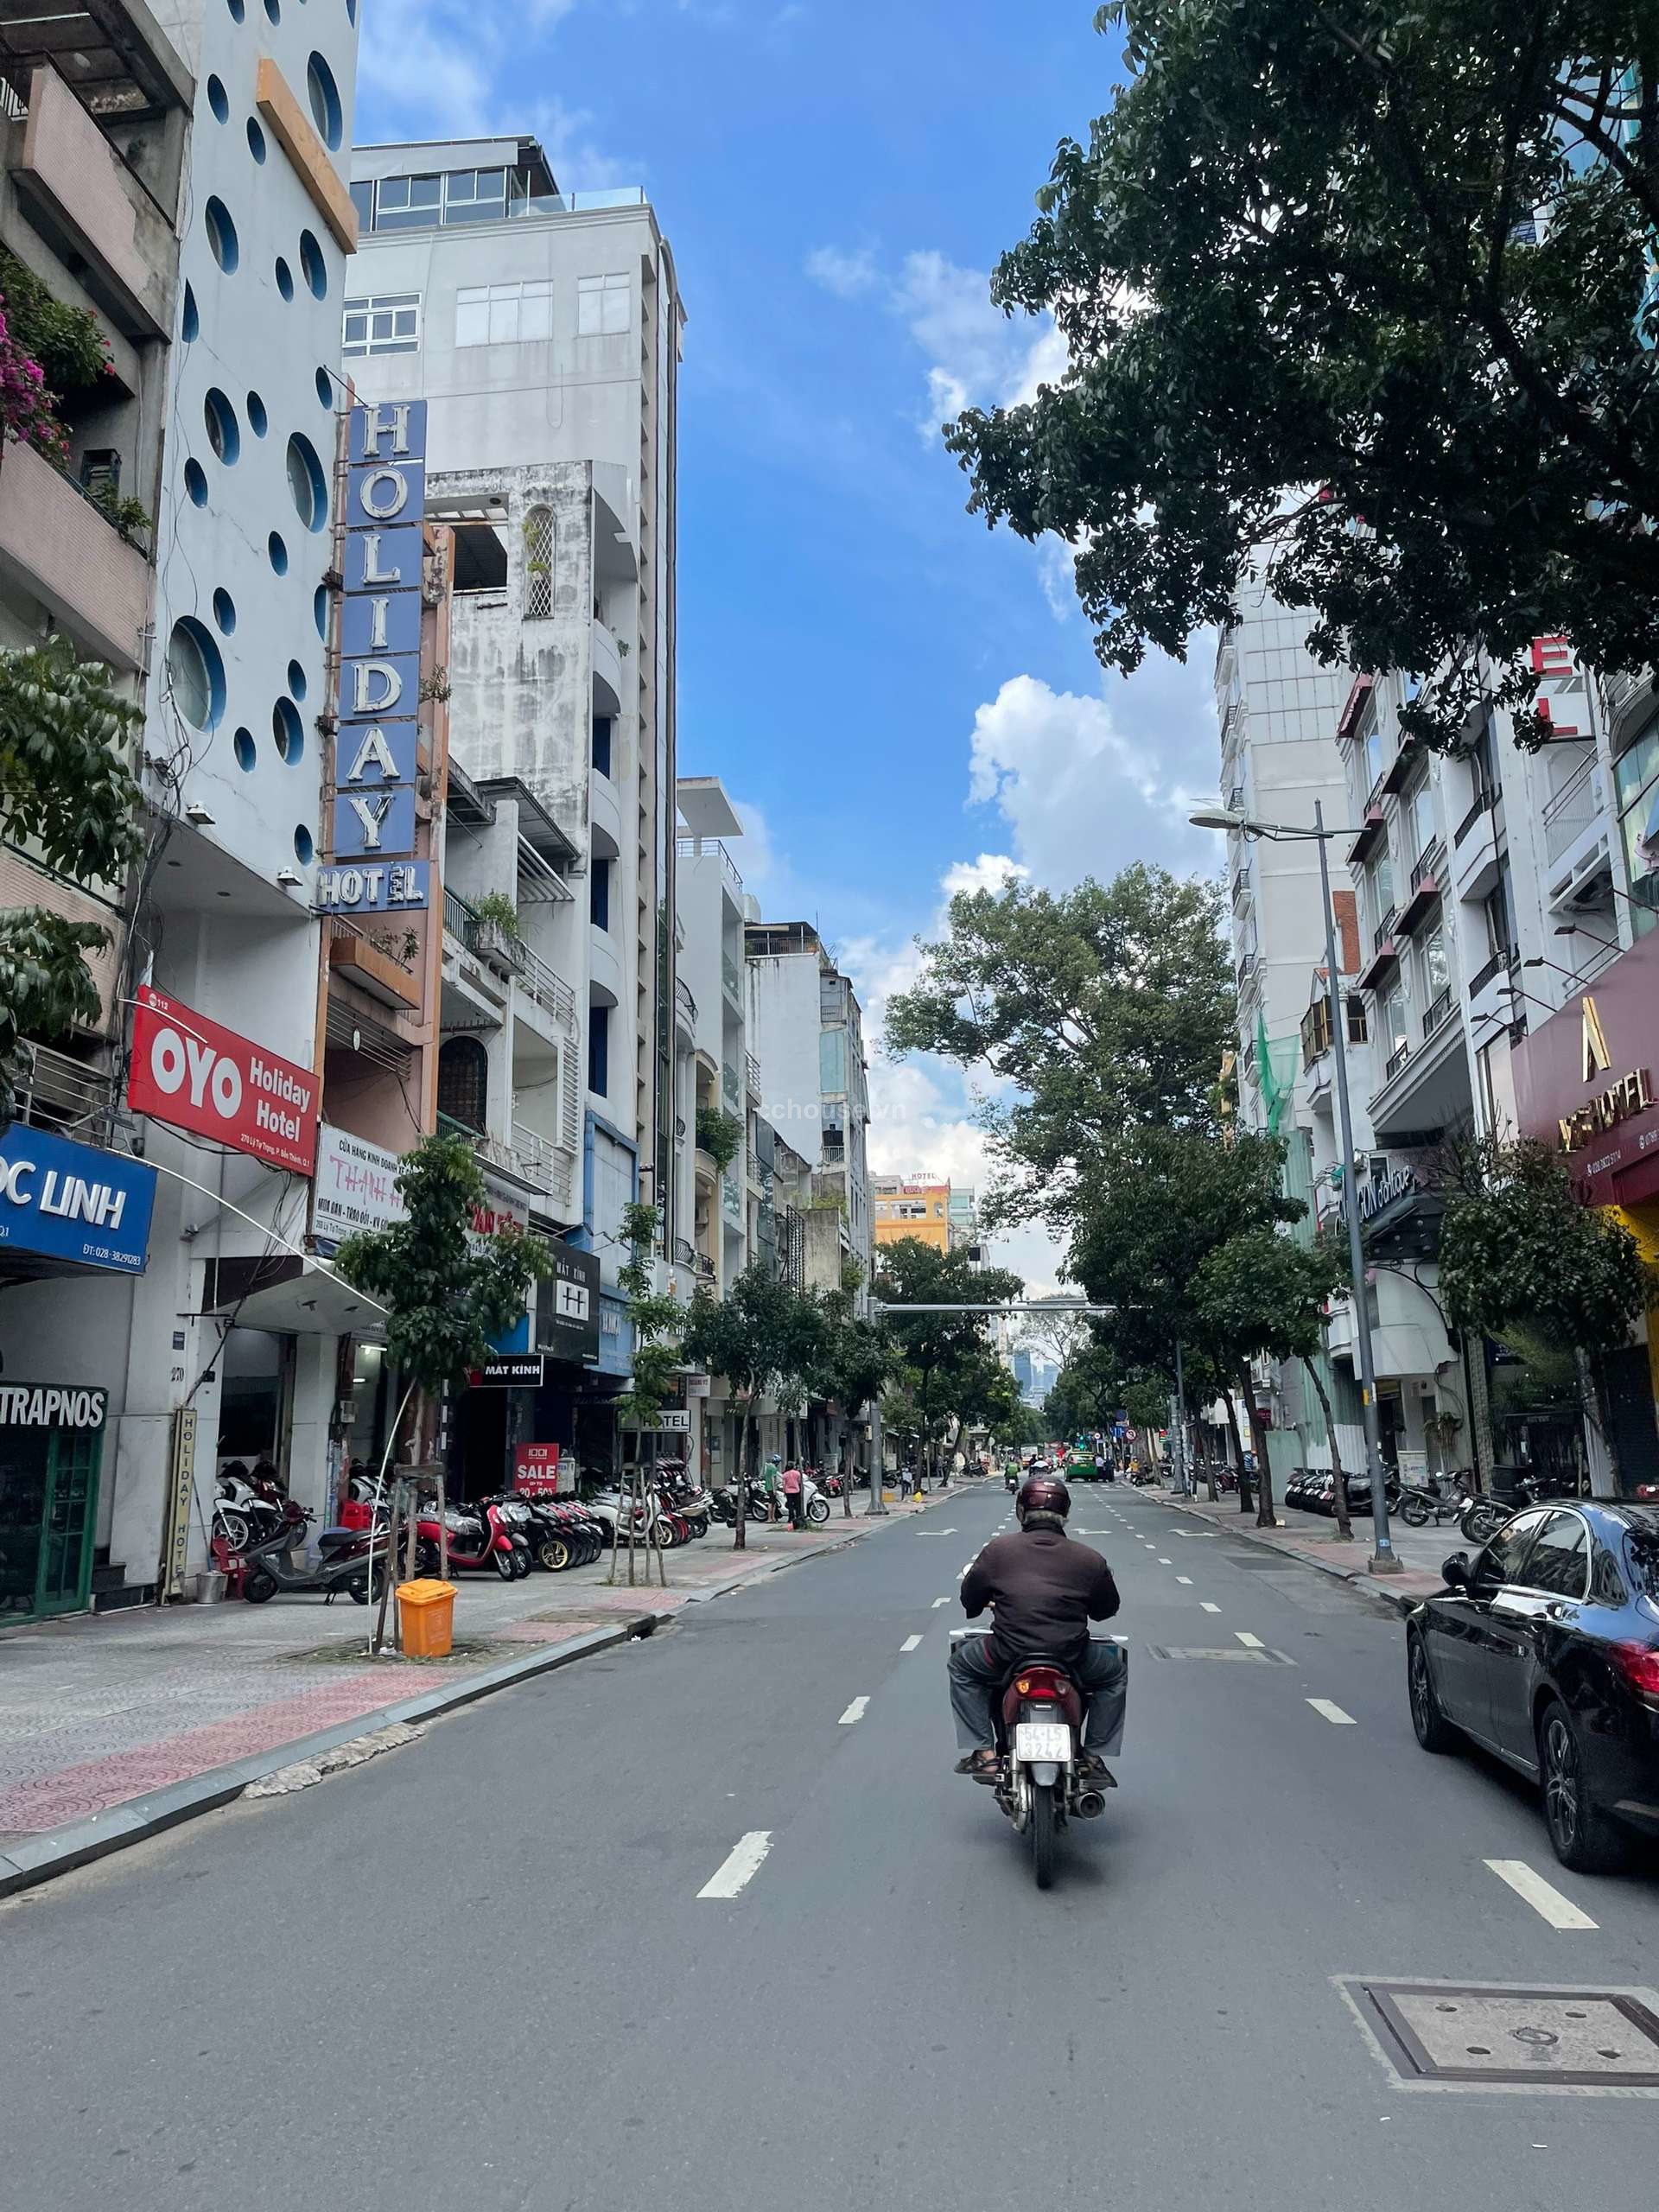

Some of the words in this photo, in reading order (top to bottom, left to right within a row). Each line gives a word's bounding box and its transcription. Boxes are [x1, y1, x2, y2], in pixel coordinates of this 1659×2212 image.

[347, 403, 410, 849] HOLIDAY
[317, 866, 424, 907] HOTEL
[150, 1027, 243, 1119] OYO
[249, 1056, 311, 1114] Holiday
[240, 1133, 250, 1144] 270
[256, 1098, 301, 1143] Hotel
[367, 1151, 380, 1166] KINH
[40, 1170, 127, 1230] LINH
[643, 1415, 689, 1427] HTEL
[180, 1418, 194, 1507] HOLIDAY
[518, 1464, 556, 1479] SALE
[174, 1523, 186, 1588] HOTE
